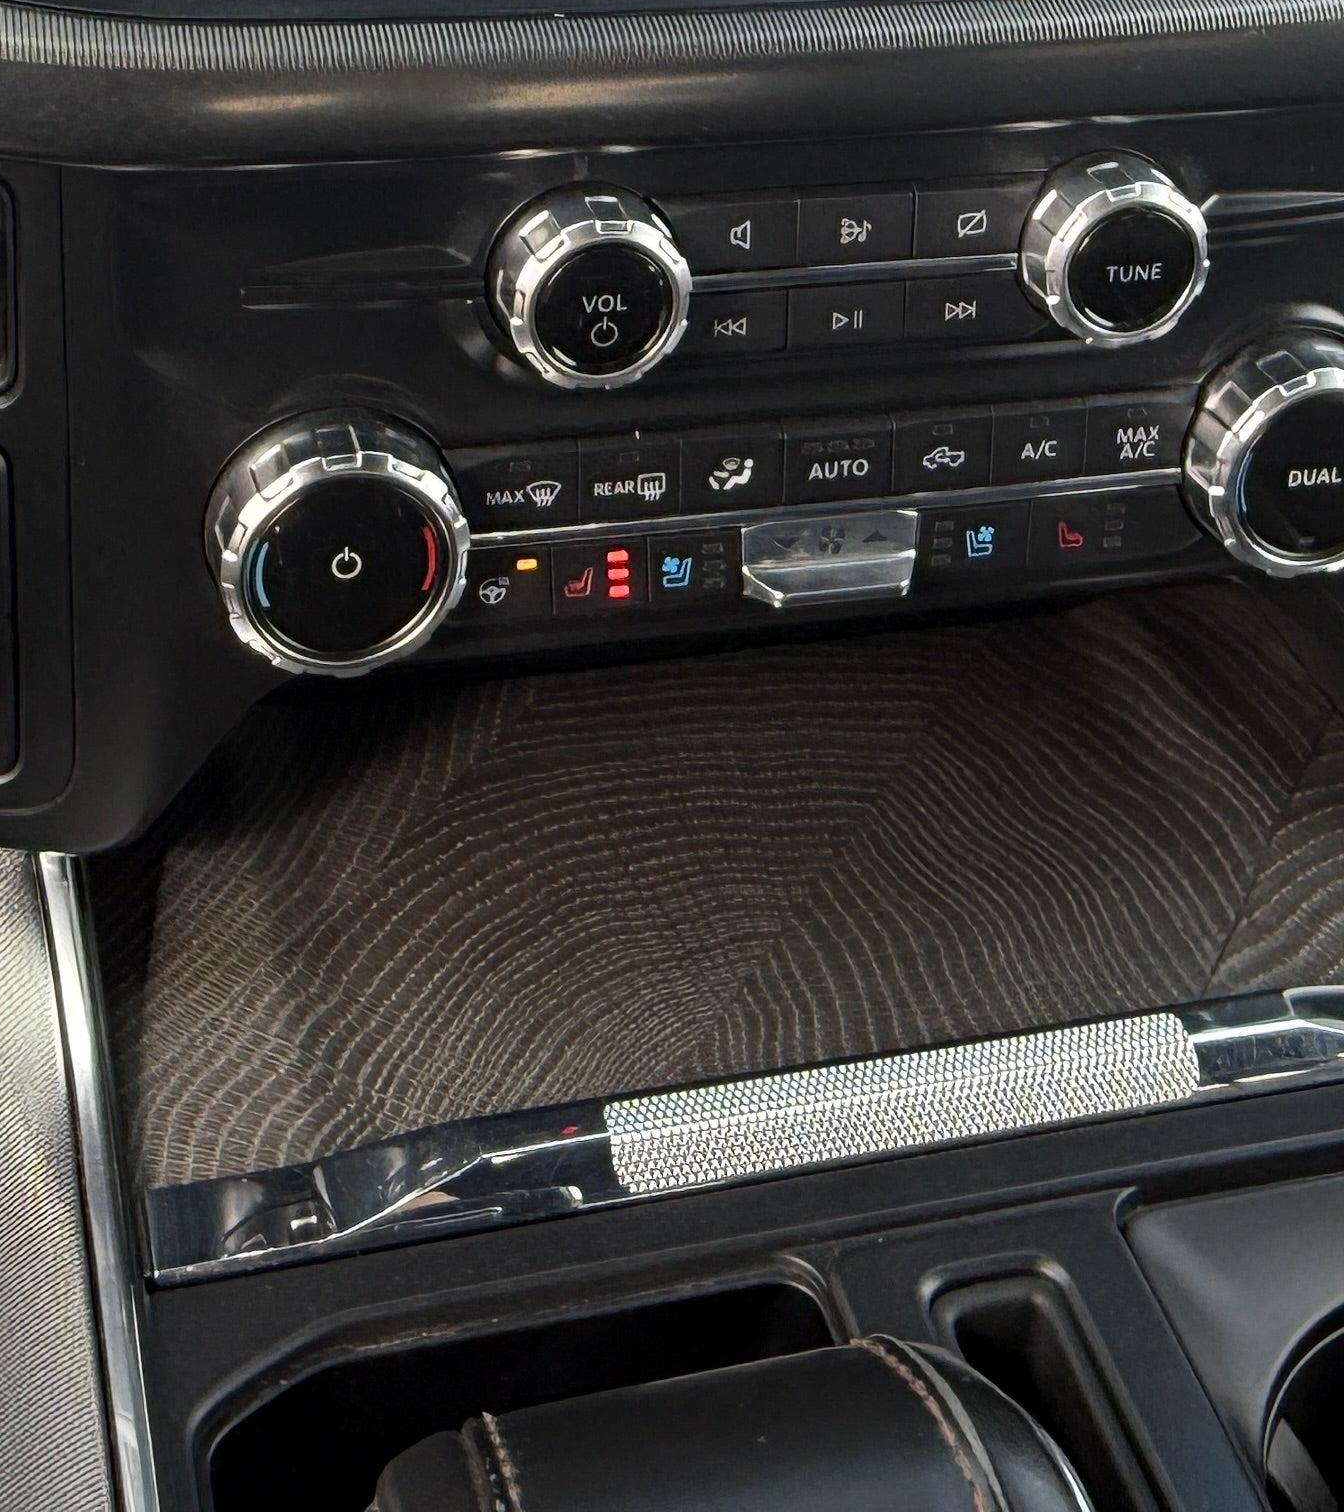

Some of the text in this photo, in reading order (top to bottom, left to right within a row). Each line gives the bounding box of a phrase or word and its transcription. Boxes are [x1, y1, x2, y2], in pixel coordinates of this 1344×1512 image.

[1105, 262, 1163, 285] TUNE
[582, 295, 627, 314] VOL
[1116, 424, 1160, 444] MAX
[1020, 439, 1058, 461] A/C
[1119, 442, 1156, 460] A/C
[808, 458, 870, 481] AUTO
[1287, 467, 1343, 487] DUAL
[486, 489, 526, 506] MAX
[594, 479, 636, 497] REAR
